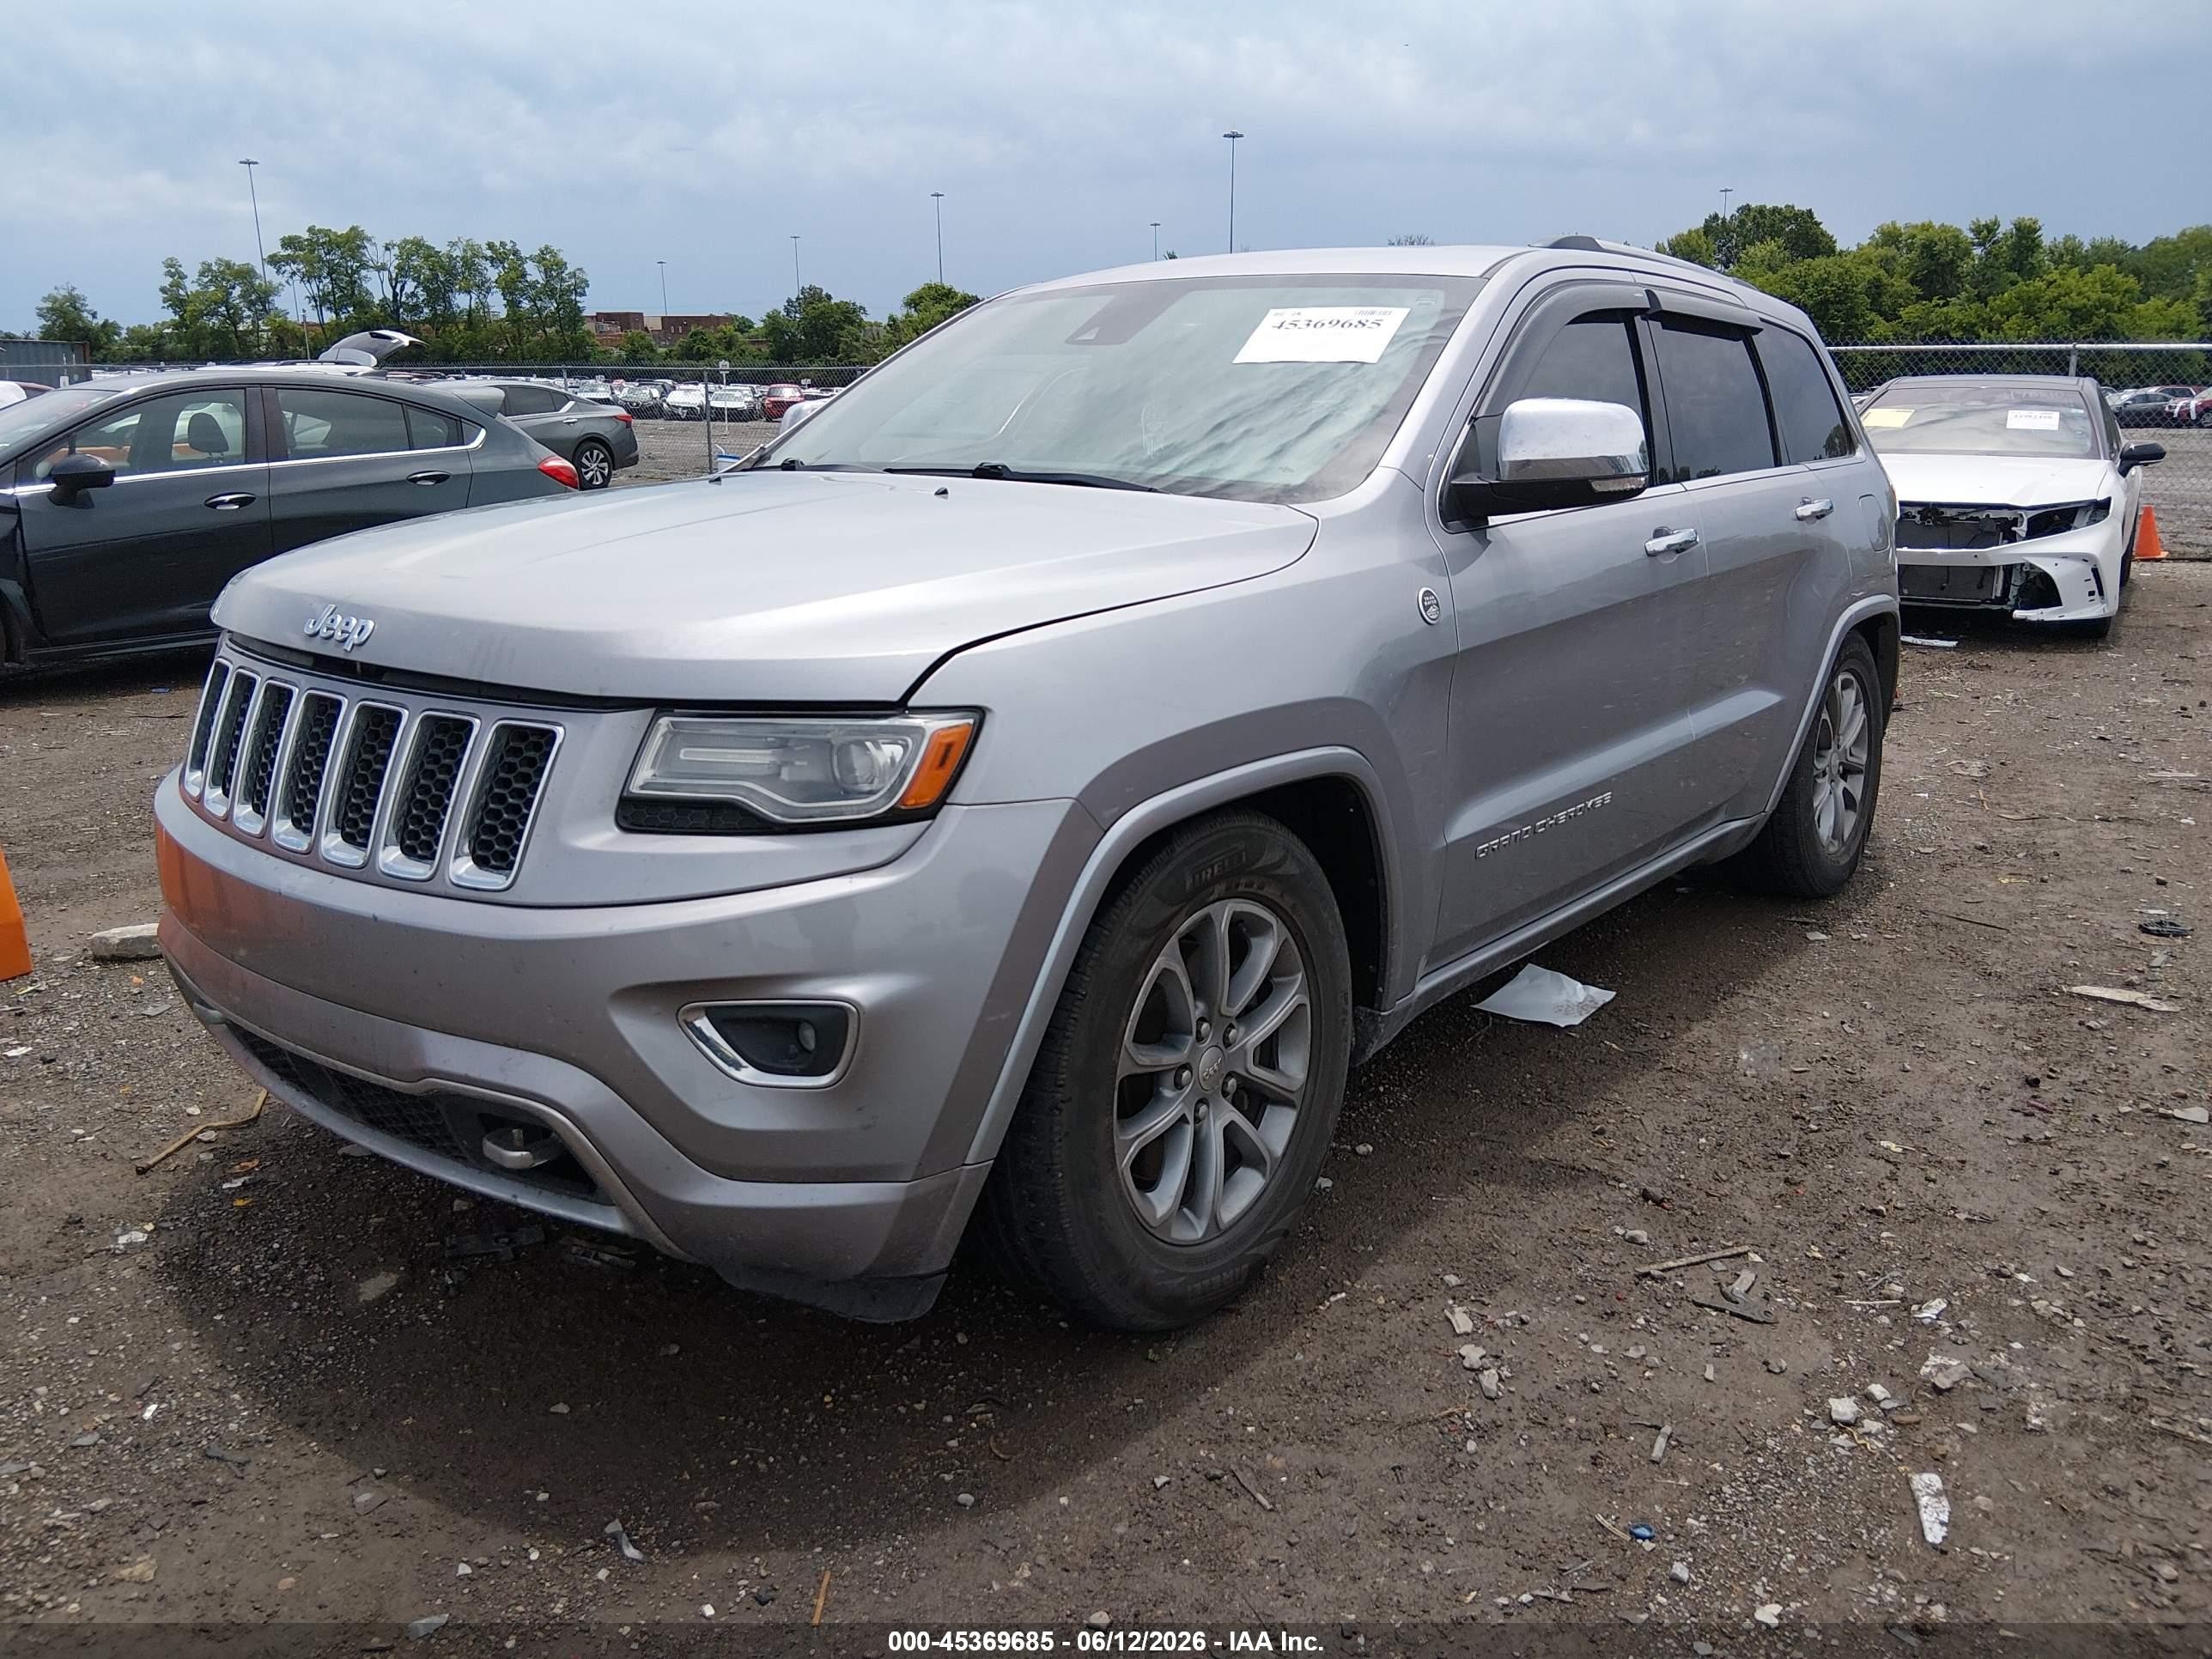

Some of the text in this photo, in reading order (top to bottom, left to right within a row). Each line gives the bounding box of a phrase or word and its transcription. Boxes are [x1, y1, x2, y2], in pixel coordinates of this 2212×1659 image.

[1271, 319, 1385, 331] 45369685
[304, 604, 375, 653] Jeep
[1474, 791, 1613, 860] GRAND CHEROKEE
